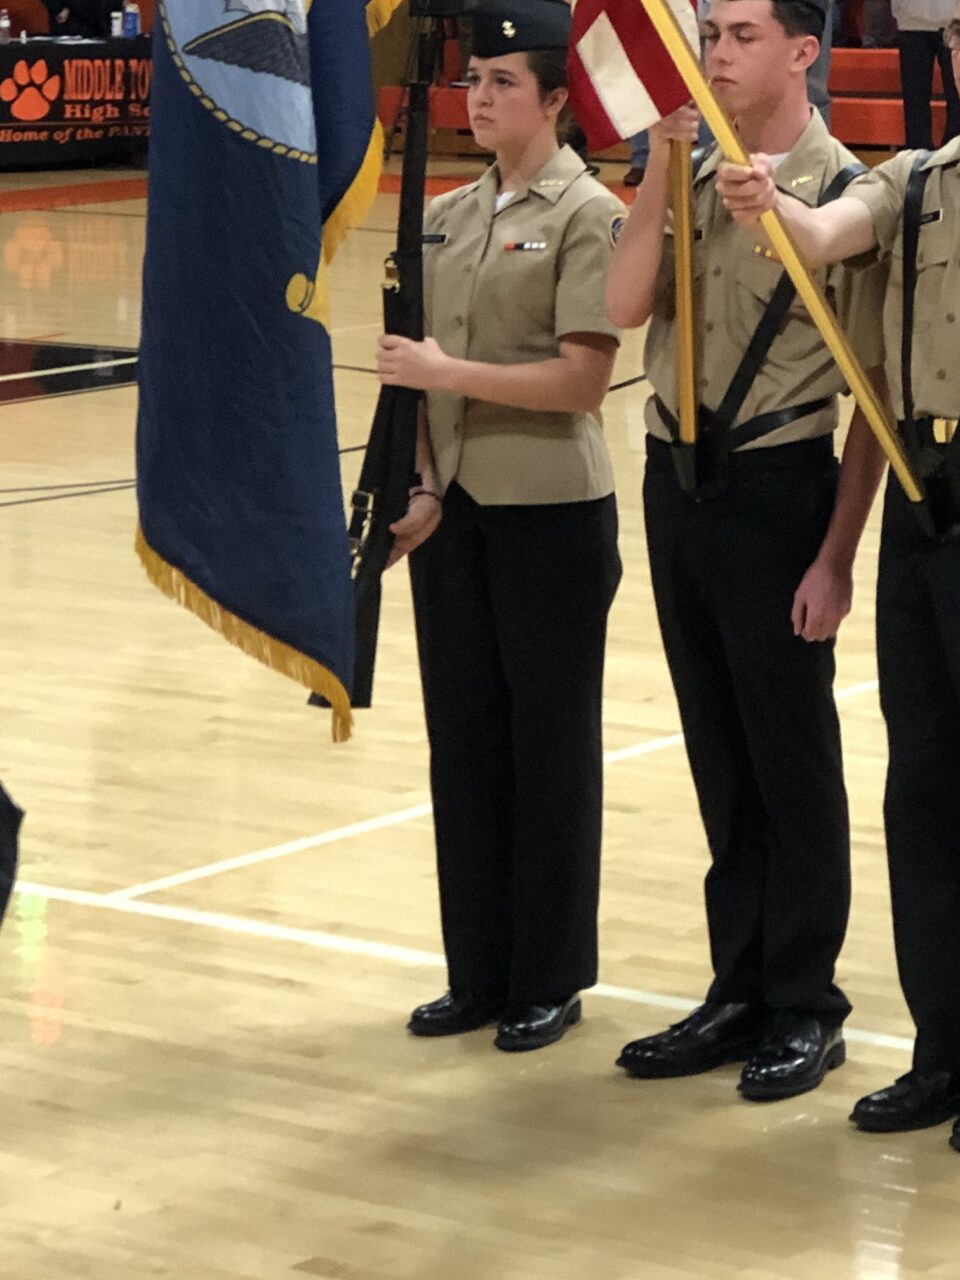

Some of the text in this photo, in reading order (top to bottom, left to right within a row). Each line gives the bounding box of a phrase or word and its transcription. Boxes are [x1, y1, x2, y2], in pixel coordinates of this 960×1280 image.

[63, 58, 152, 100] MIDDLE TO
[63, 104, 120, 124] High
[0, 128, 48, 143] Home
[52, 127, 73, 144] of
[76, 127, 103, 141] the
